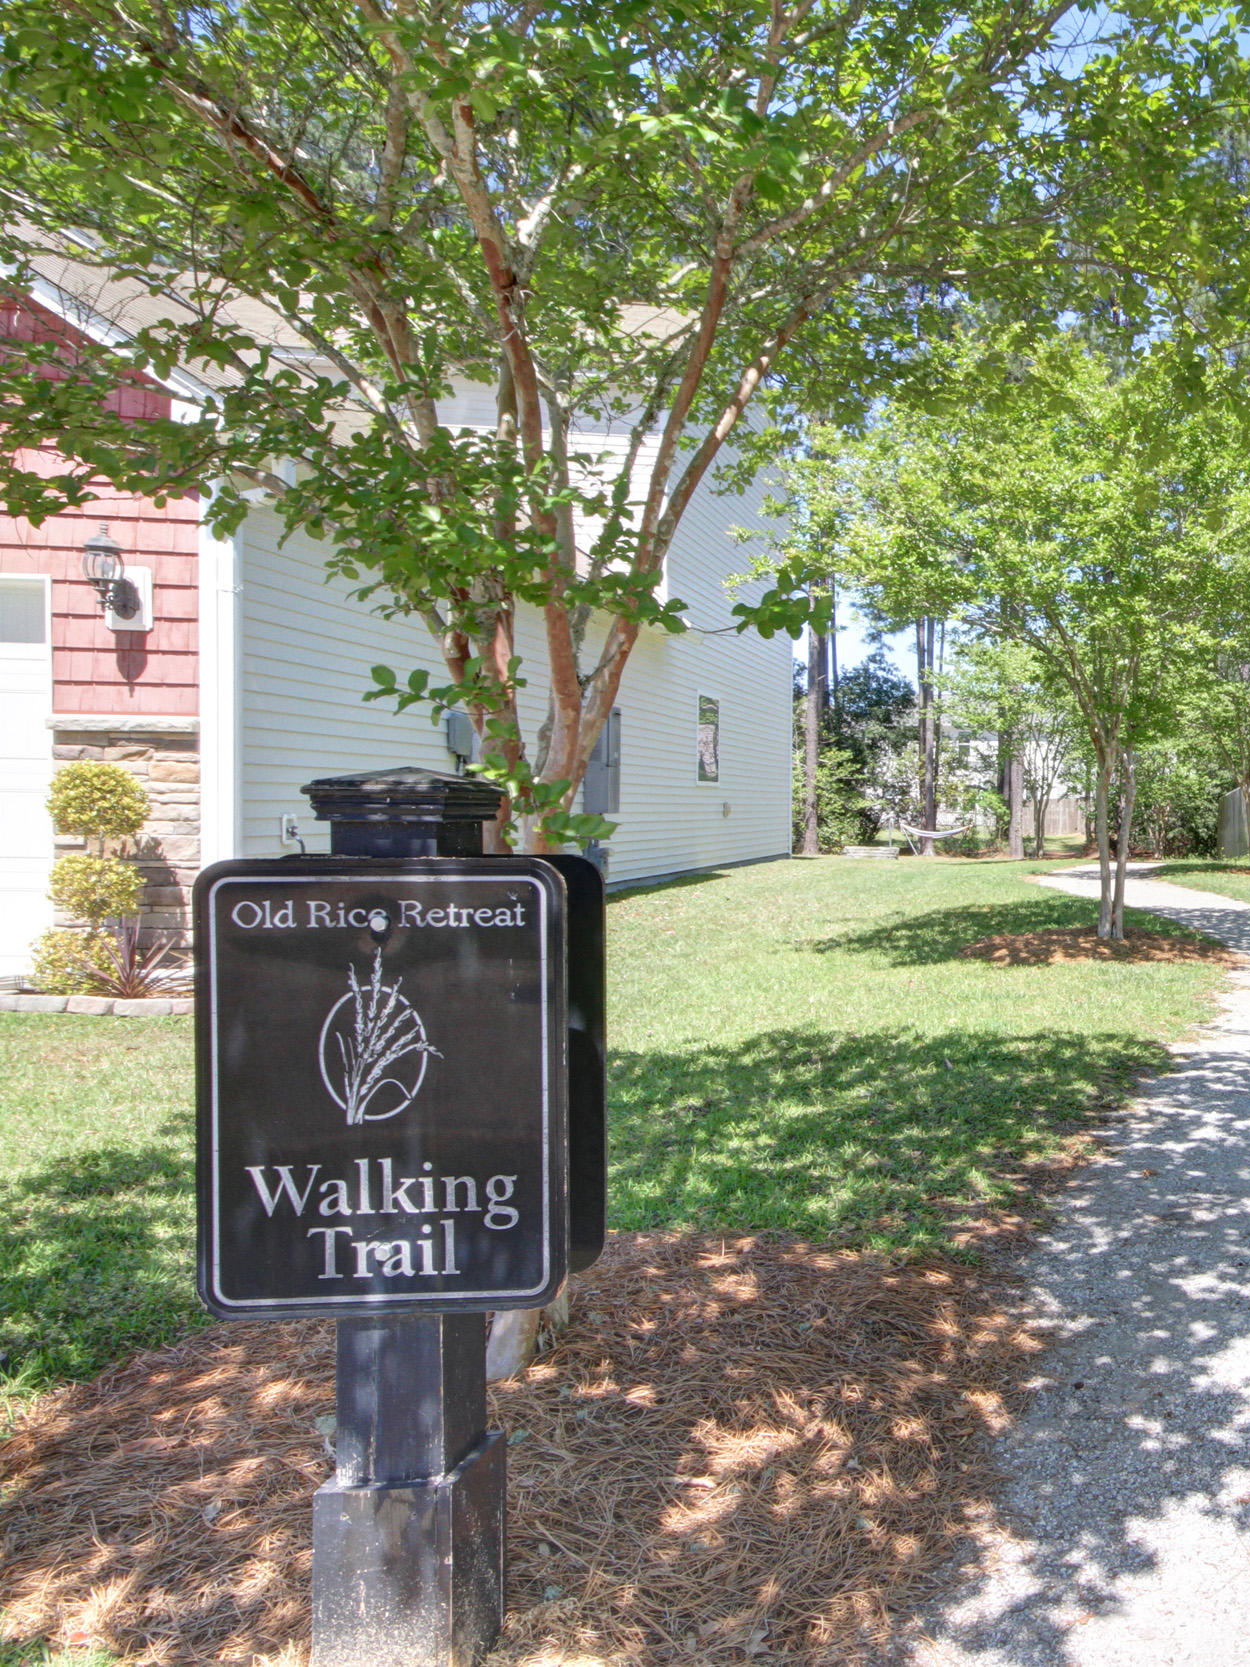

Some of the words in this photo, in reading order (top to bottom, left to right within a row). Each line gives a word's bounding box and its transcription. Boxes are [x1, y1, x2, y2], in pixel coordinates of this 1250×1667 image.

[231, 900, 297, 929] Old
[398, 900, 526, 928] Retreat
[245, 1158, 519, 1230] Walking
[307, 1219, 461, 1279] Trail
